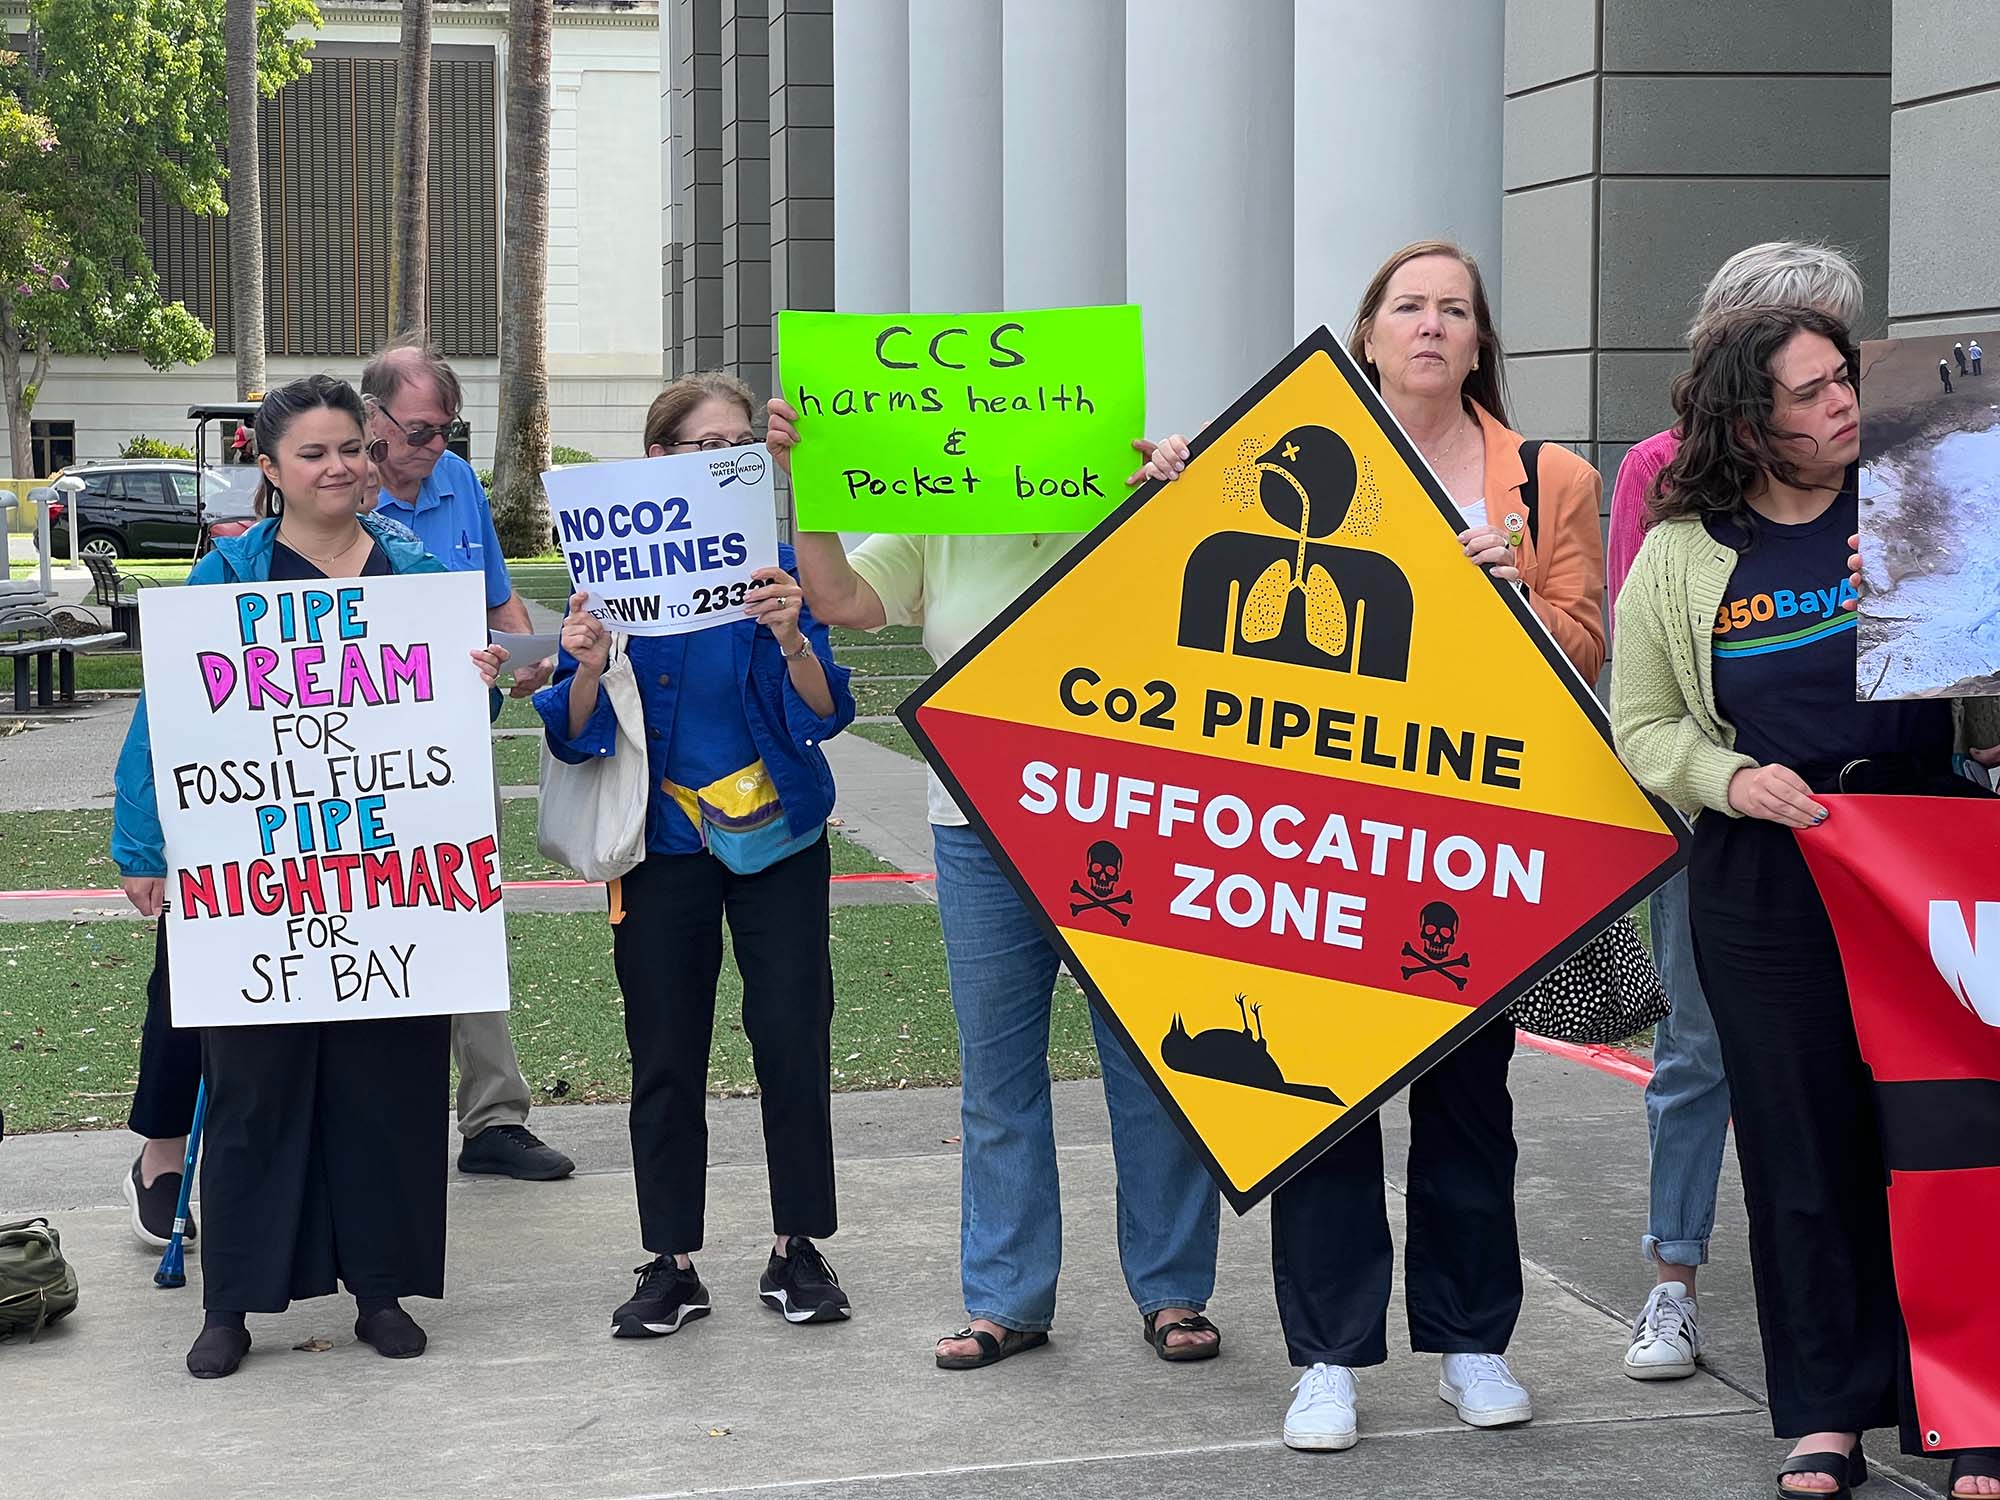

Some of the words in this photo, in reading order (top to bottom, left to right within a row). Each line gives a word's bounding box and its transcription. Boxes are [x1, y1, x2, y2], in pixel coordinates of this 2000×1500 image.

[876, 323, 1026, 370] CCS
[799, 385, 944, 417] harms
[966, 383, 1095, 416] health
[711, 467, 735, 478] WATER
[737, 464, 763, 473] WATCH
[842, 466, 982, 500] Pocket
[1014, 464, 1106, 501] book
[559, 505, 605, 543] NO
[608, 497, 692, 538] CO2
[568, 532, 748, 585] PIPELINES
[235, 586, 368, 647] PIPE
[603, 595, 660, 622] FWW
[667, 604, 690, 619] TO
[692, 577, 775, 615] 233
[196, 643, 434, 714] DREAM
[272, 711, 356, 756] FOR
[1202, 689, 1526, 791] PIPELINE
[172, 759, 315, 810] FOSSIL
[255, 793, 396, 856] PIPE
[1018, 760, 1546, 905] SUFFOCATION
[178, 834, 503, 920] NIGHTMARE
[1169, 862, 1368, 951] ZONE
[286, 915, 360, 951] FOR
[241, 953, 302, 1004] S.F.
[330, 943, 417, 1003] BAY
